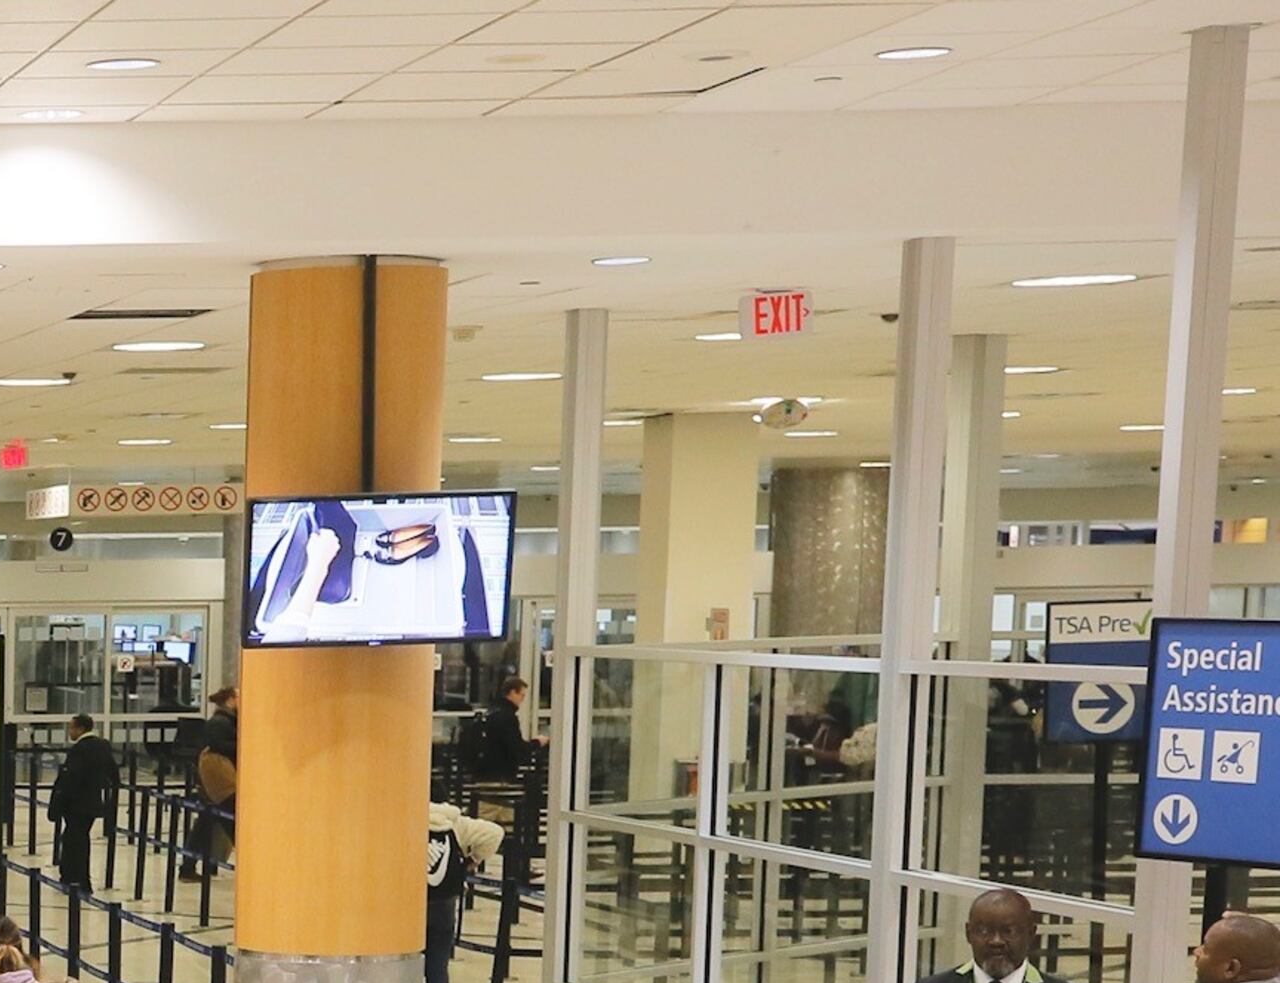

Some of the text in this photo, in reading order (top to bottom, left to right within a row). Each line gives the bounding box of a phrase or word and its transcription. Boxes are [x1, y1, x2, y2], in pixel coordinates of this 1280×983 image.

[755, 293, 804, 334] EXIT
[57, 532, 66, 546] 7
[1055, 616, 1131, 634] TSA Pre
[1167, 641, 1262, 676] Special
